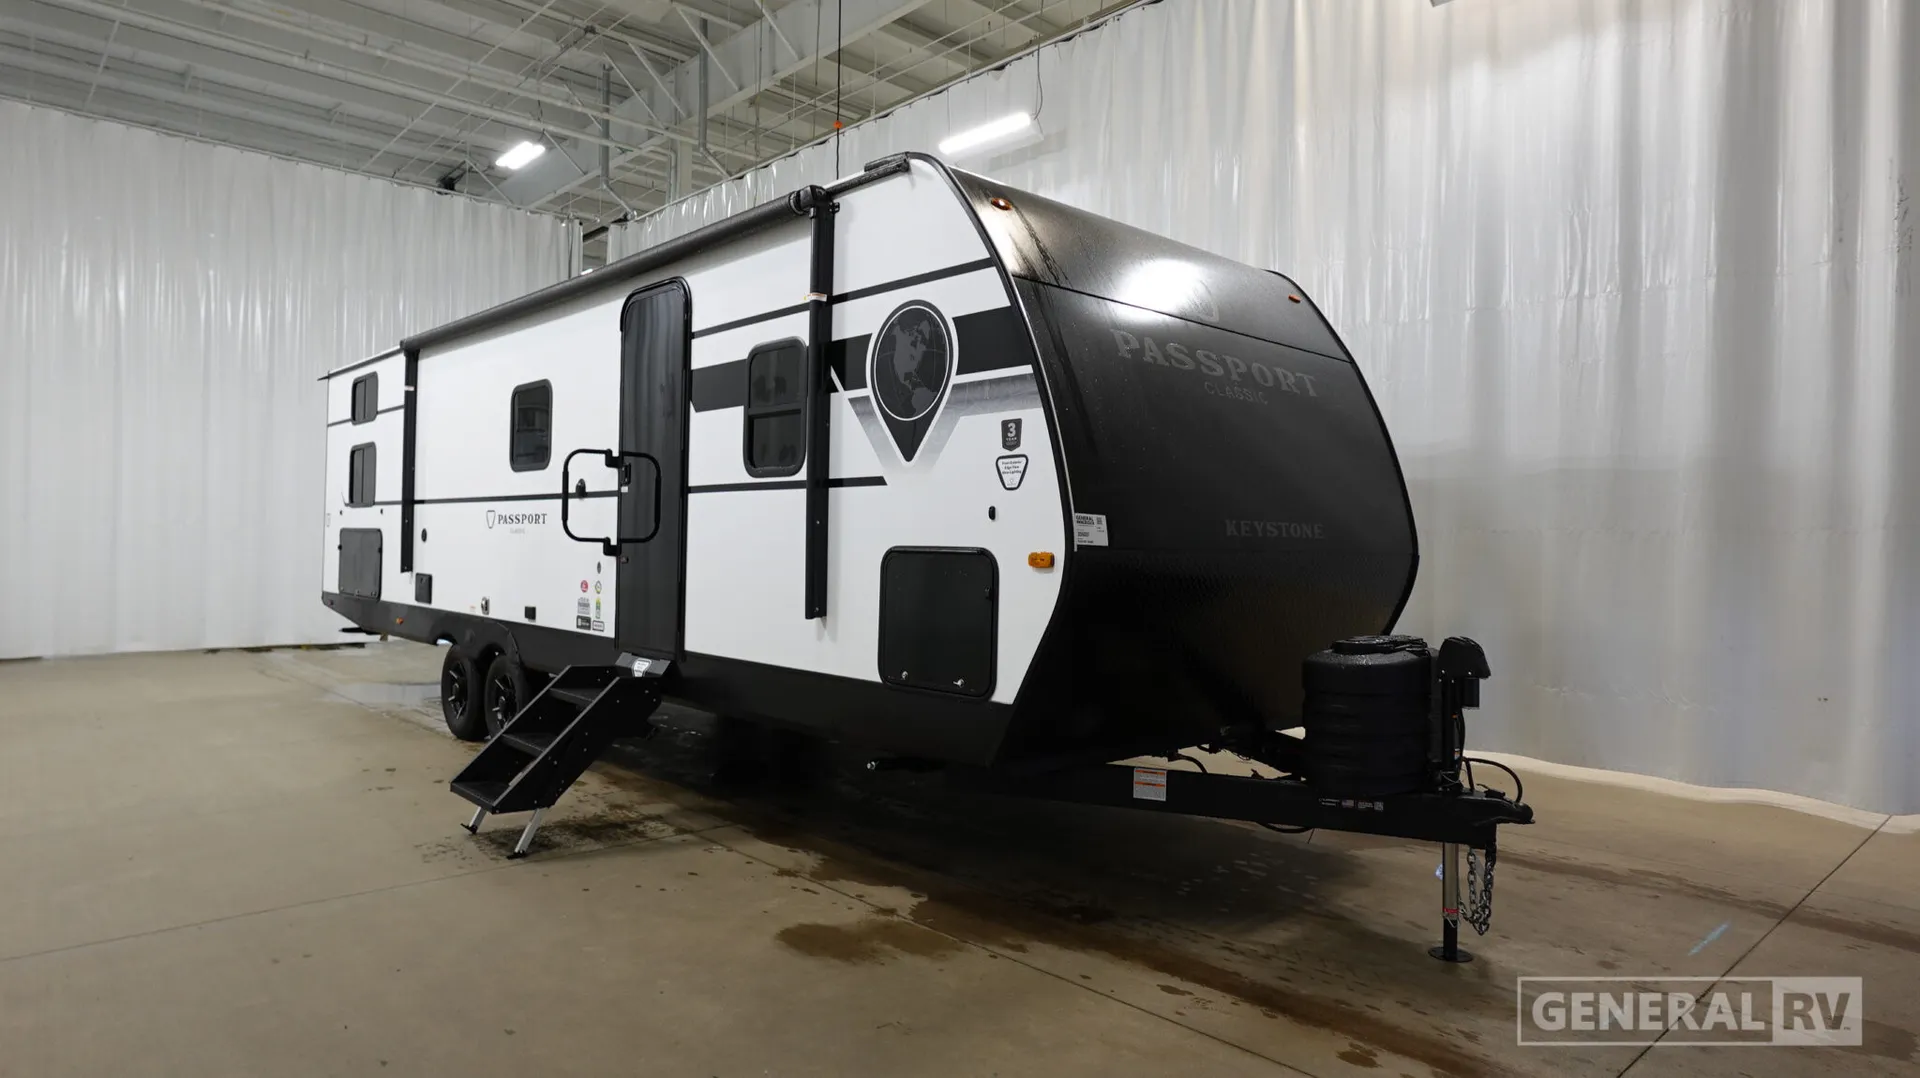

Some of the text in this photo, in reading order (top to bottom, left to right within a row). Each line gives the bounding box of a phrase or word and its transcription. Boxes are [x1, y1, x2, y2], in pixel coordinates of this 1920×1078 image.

[1110, 329, 1318, 397] PASSPORT
[1204, 381, 1268, 405] CLASSIC
[1007, 422, 1016, 438] 3
[497, 513, 547, 524] PASSPORT
[1225, 519, 1325, 539] KEYSTONE
